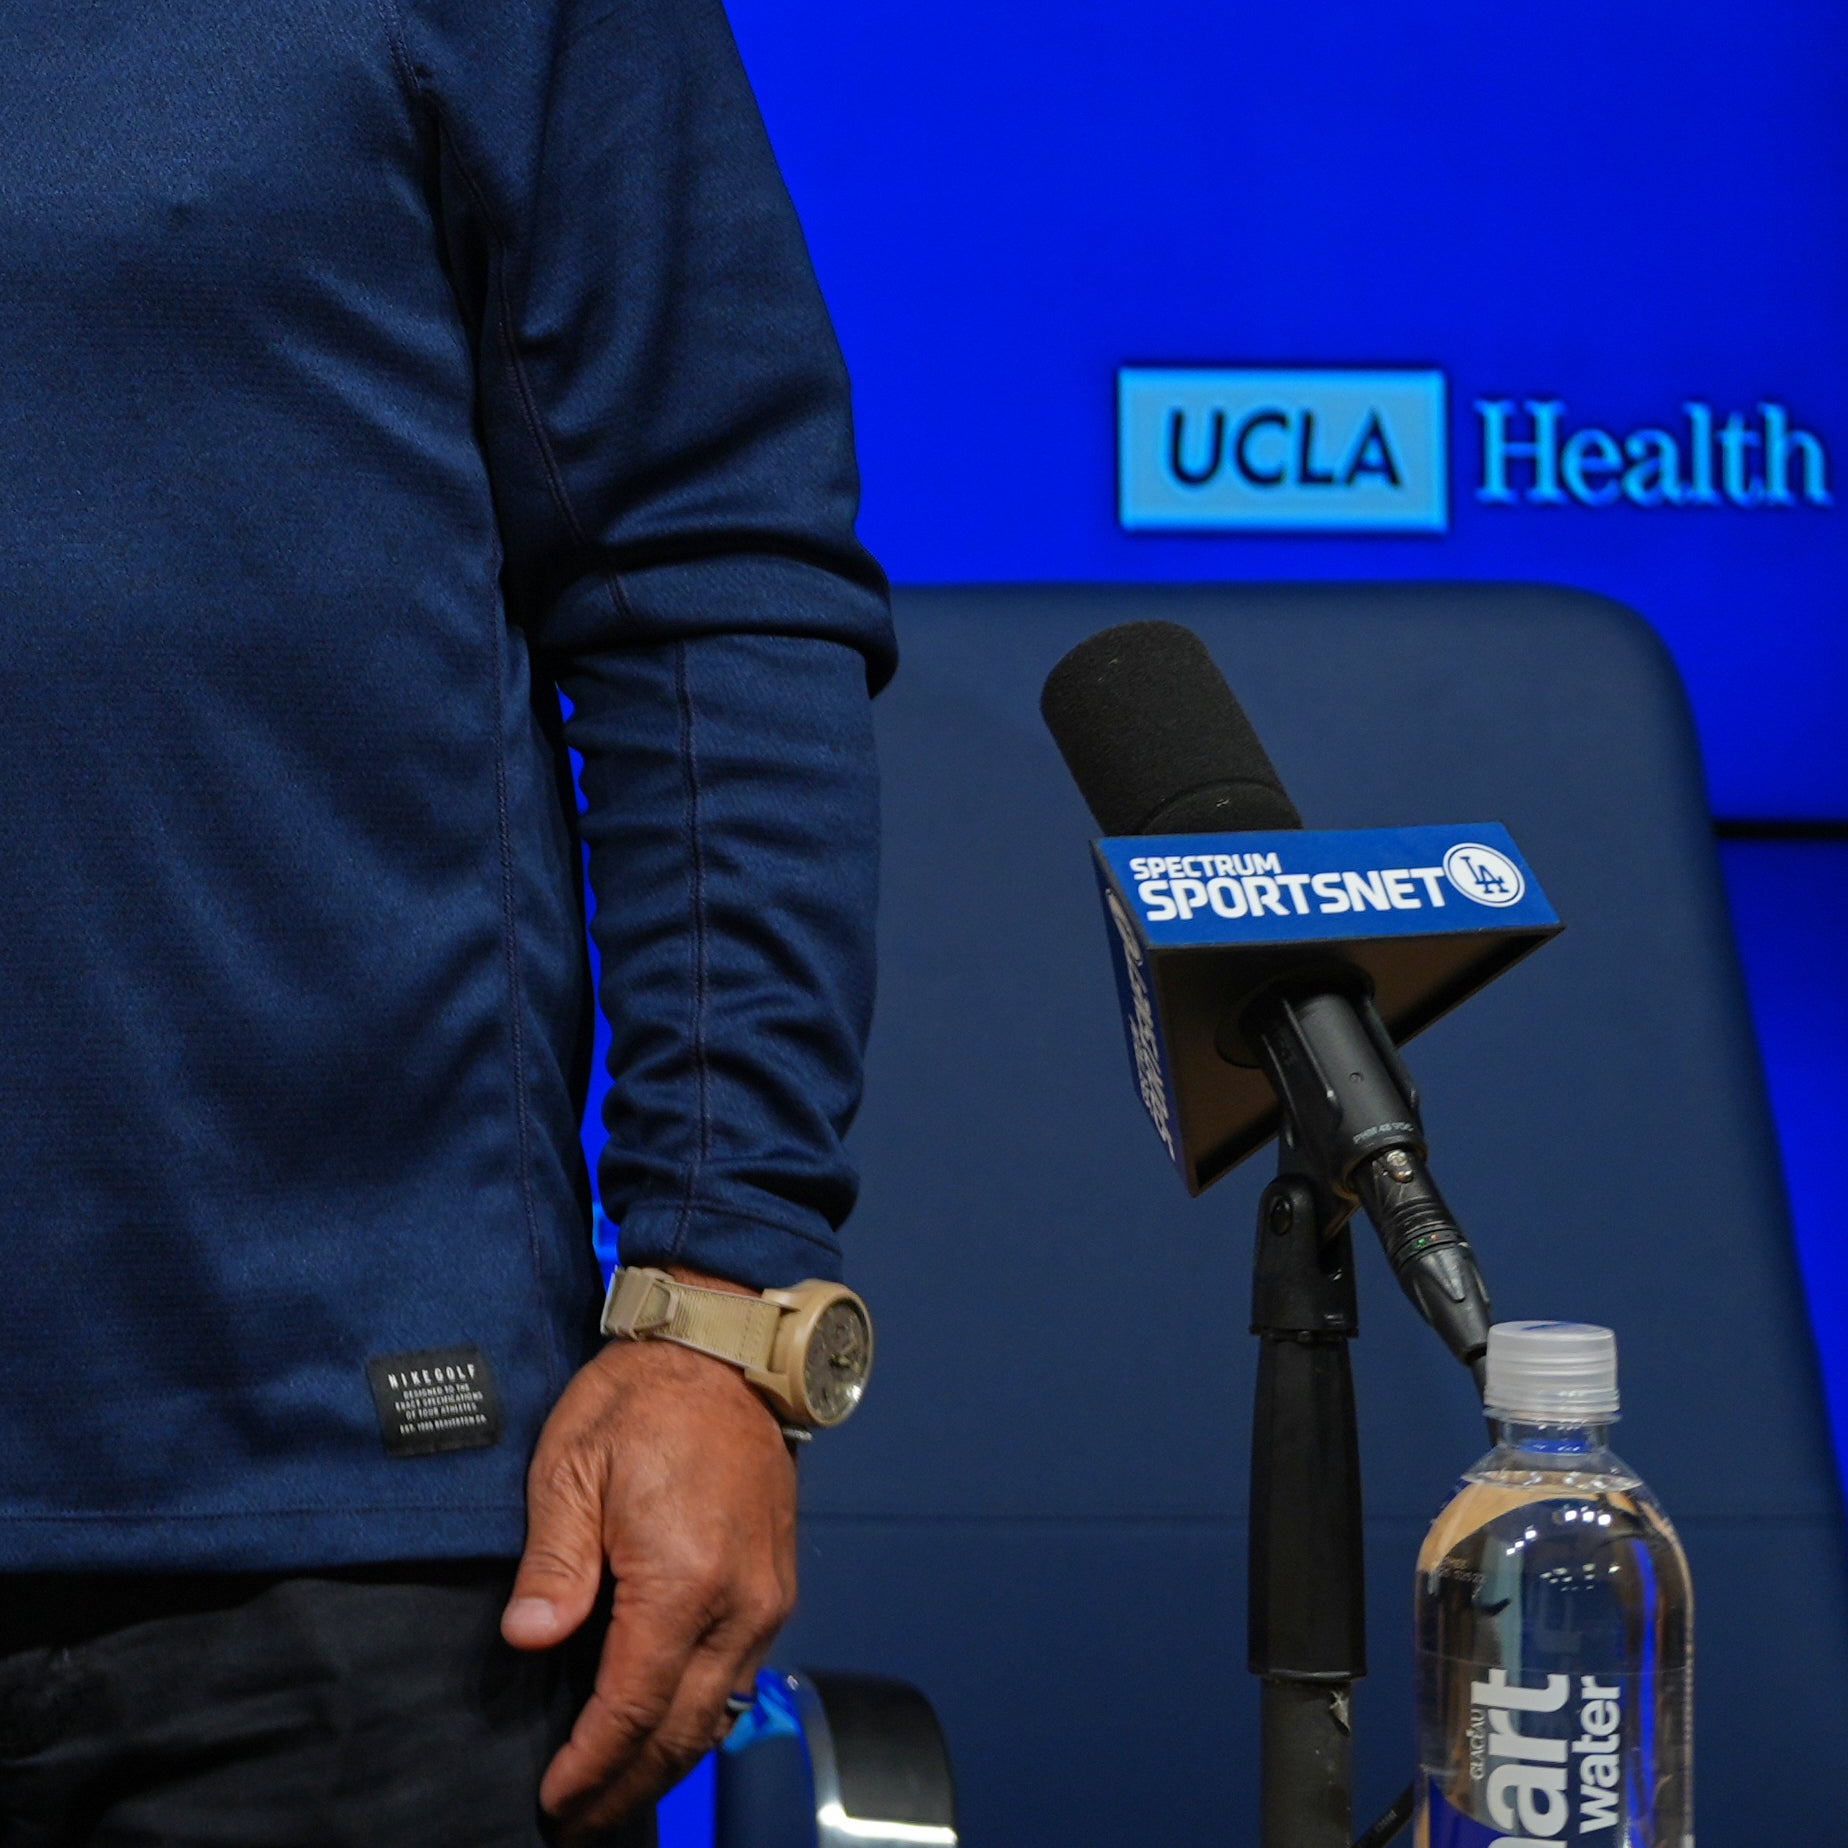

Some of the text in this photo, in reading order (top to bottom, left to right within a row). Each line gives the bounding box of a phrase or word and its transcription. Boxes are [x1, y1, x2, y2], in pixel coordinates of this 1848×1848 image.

[1167, 398, 1833, 507] UCLA Health
[1129, 852, 1282, 881] SPECTRUM
[1460, 856, 1510, 894] LA
[1138, 867, 1449, 921] SPORTSNET
[388, 1364, 475, 1390] NIKE GOLF
[1471, 1669, 1570, 1848] art
[1572, 1676, 1620, 1834] water
